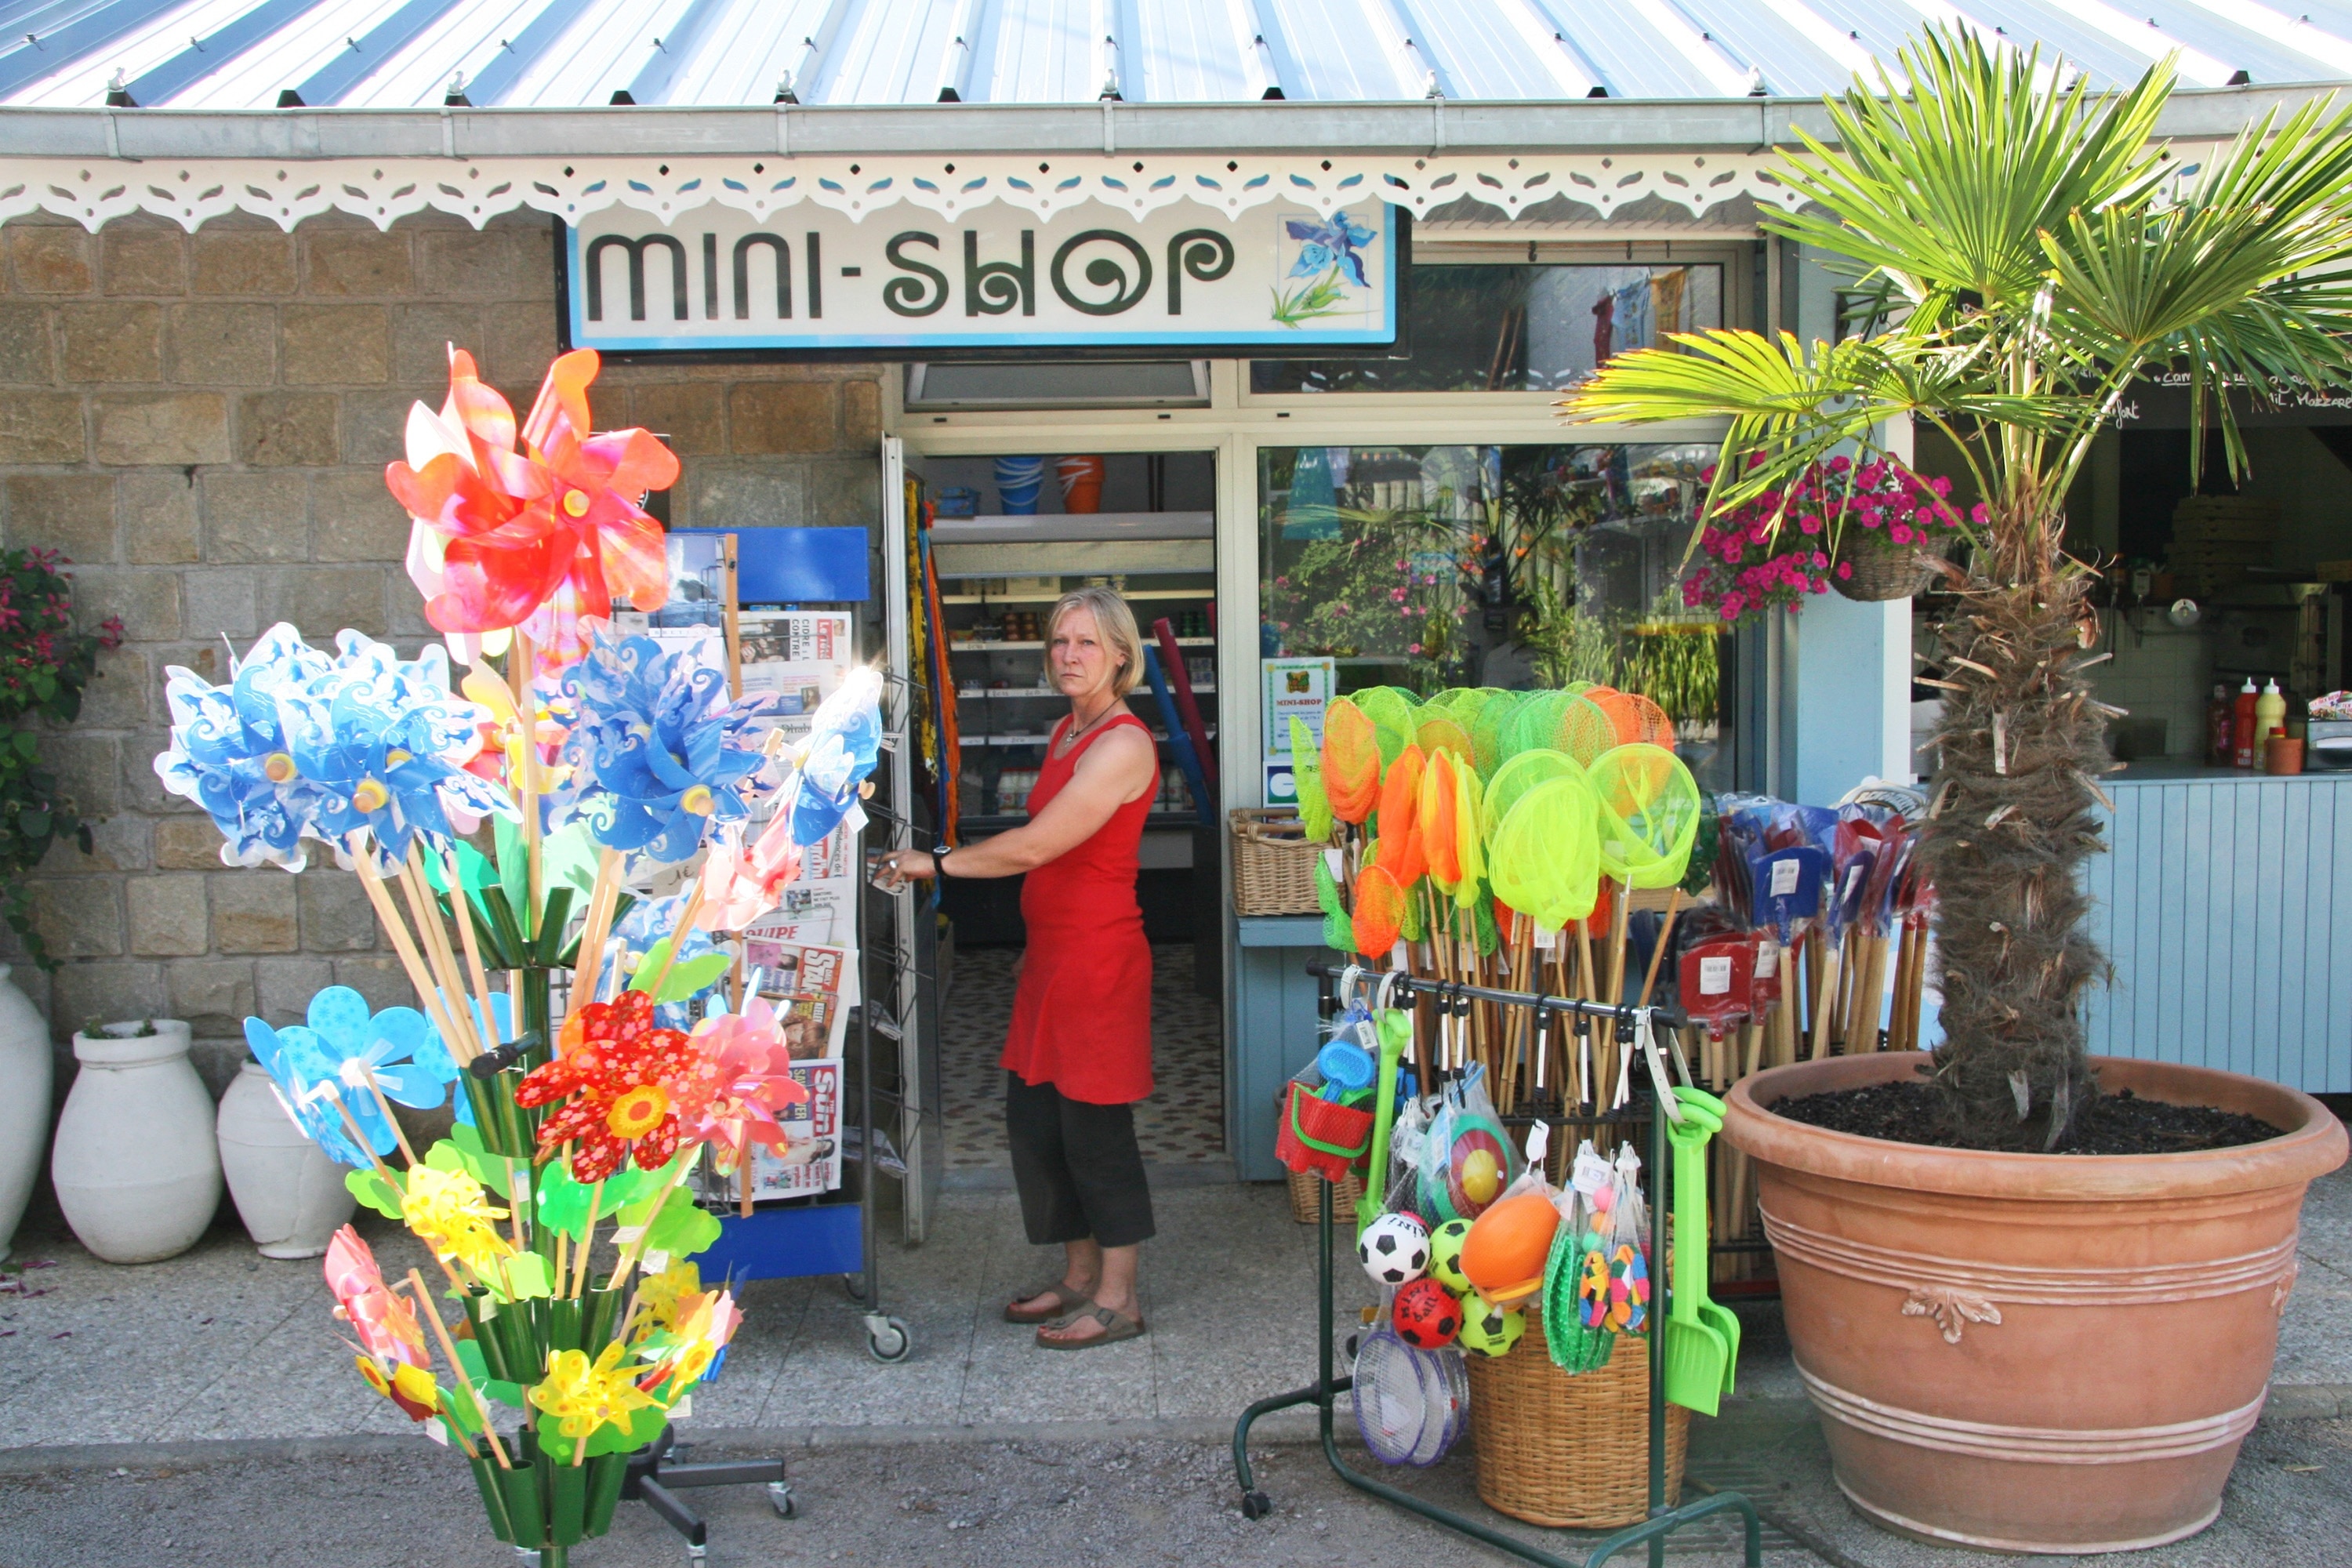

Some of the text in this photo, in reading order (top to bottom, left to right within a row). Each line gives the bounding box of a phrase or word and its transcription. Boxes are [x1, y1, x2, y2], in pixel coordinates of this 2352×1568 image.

[791, 619, 800, 657] CONTRE
[801, 619, 811, 647] CIDRE
[801, 949, 836, 994] STAR
[824, 968, 833, 986] DAILY
[815, 1069, 835, 1134] Sun
